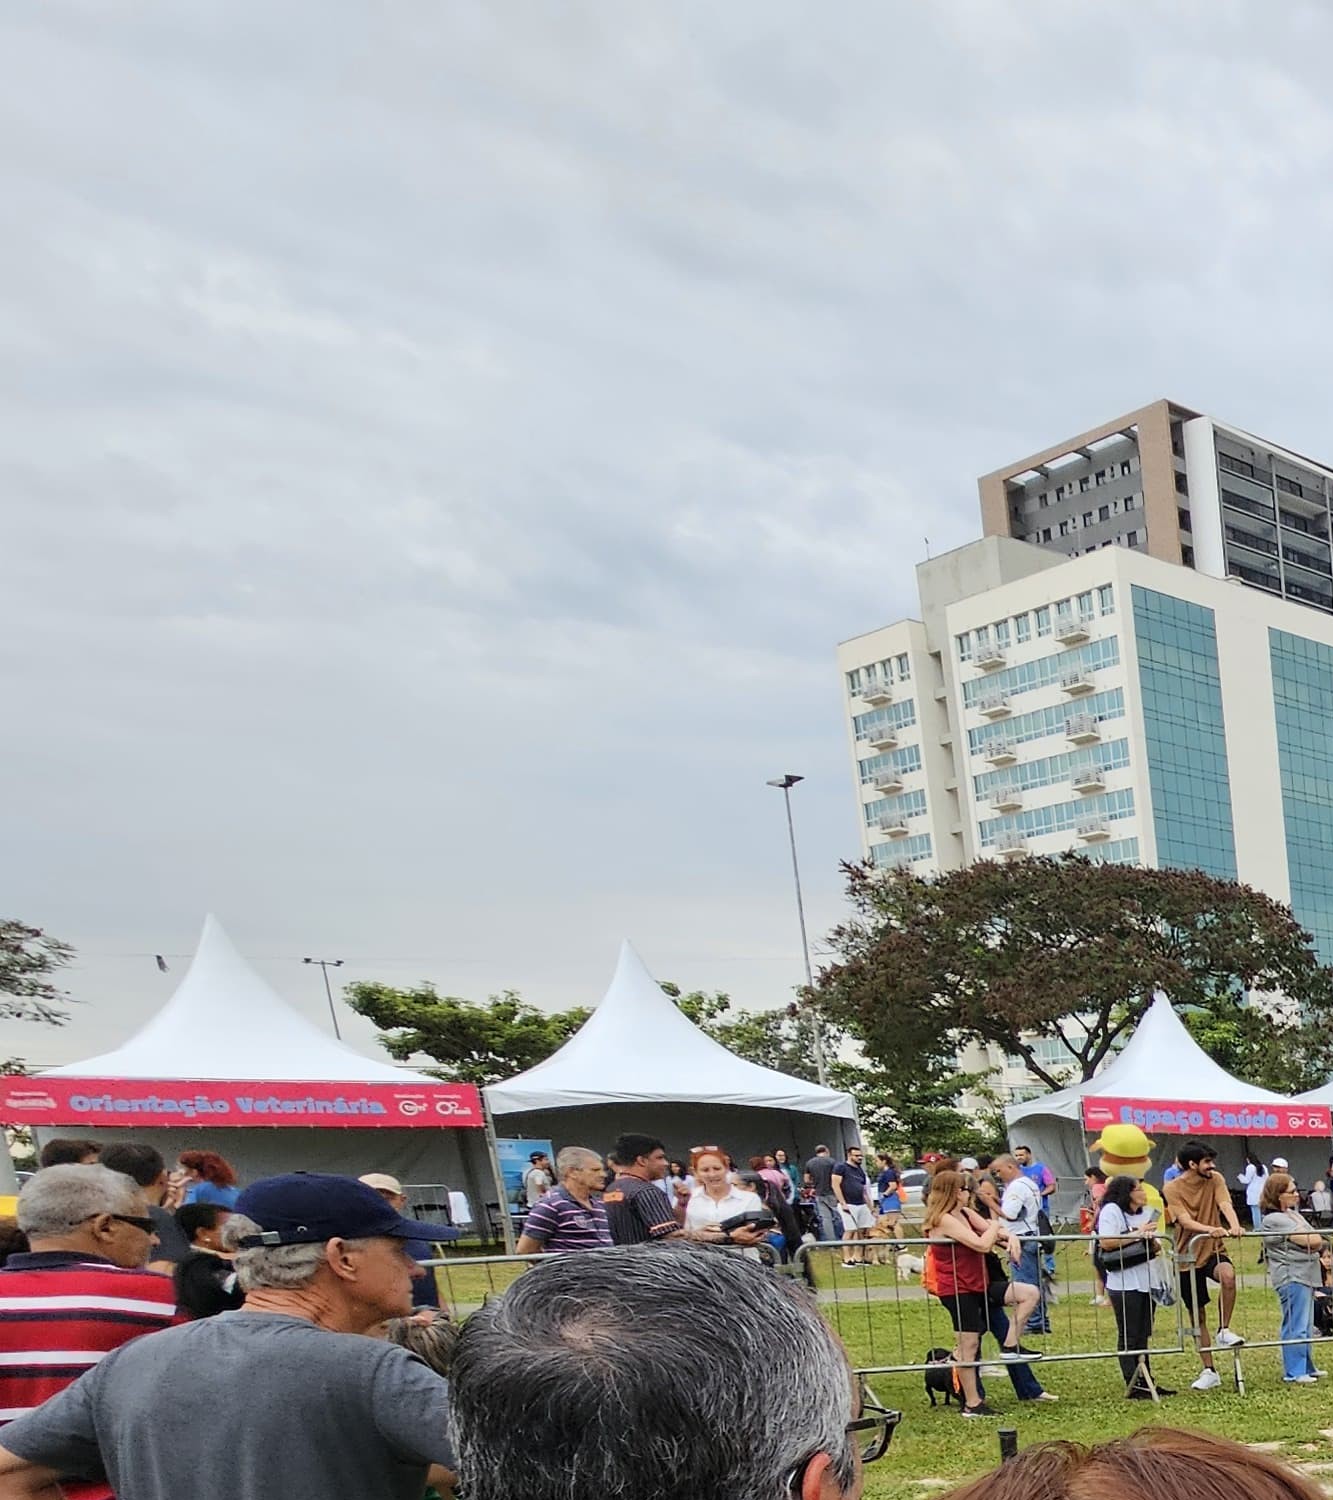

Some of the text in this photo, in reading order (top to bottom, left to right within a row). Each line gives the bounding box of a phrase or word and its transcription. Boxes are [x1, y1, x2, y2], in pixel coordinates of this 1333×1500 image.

[69, 1094, 230, 1118] Orientação
[235, 1096, 388, 1115] Veterinária
[1119, 1105, 1204, 1132] Espaço
[1209, 1108, 1278, 1129] Saúde
